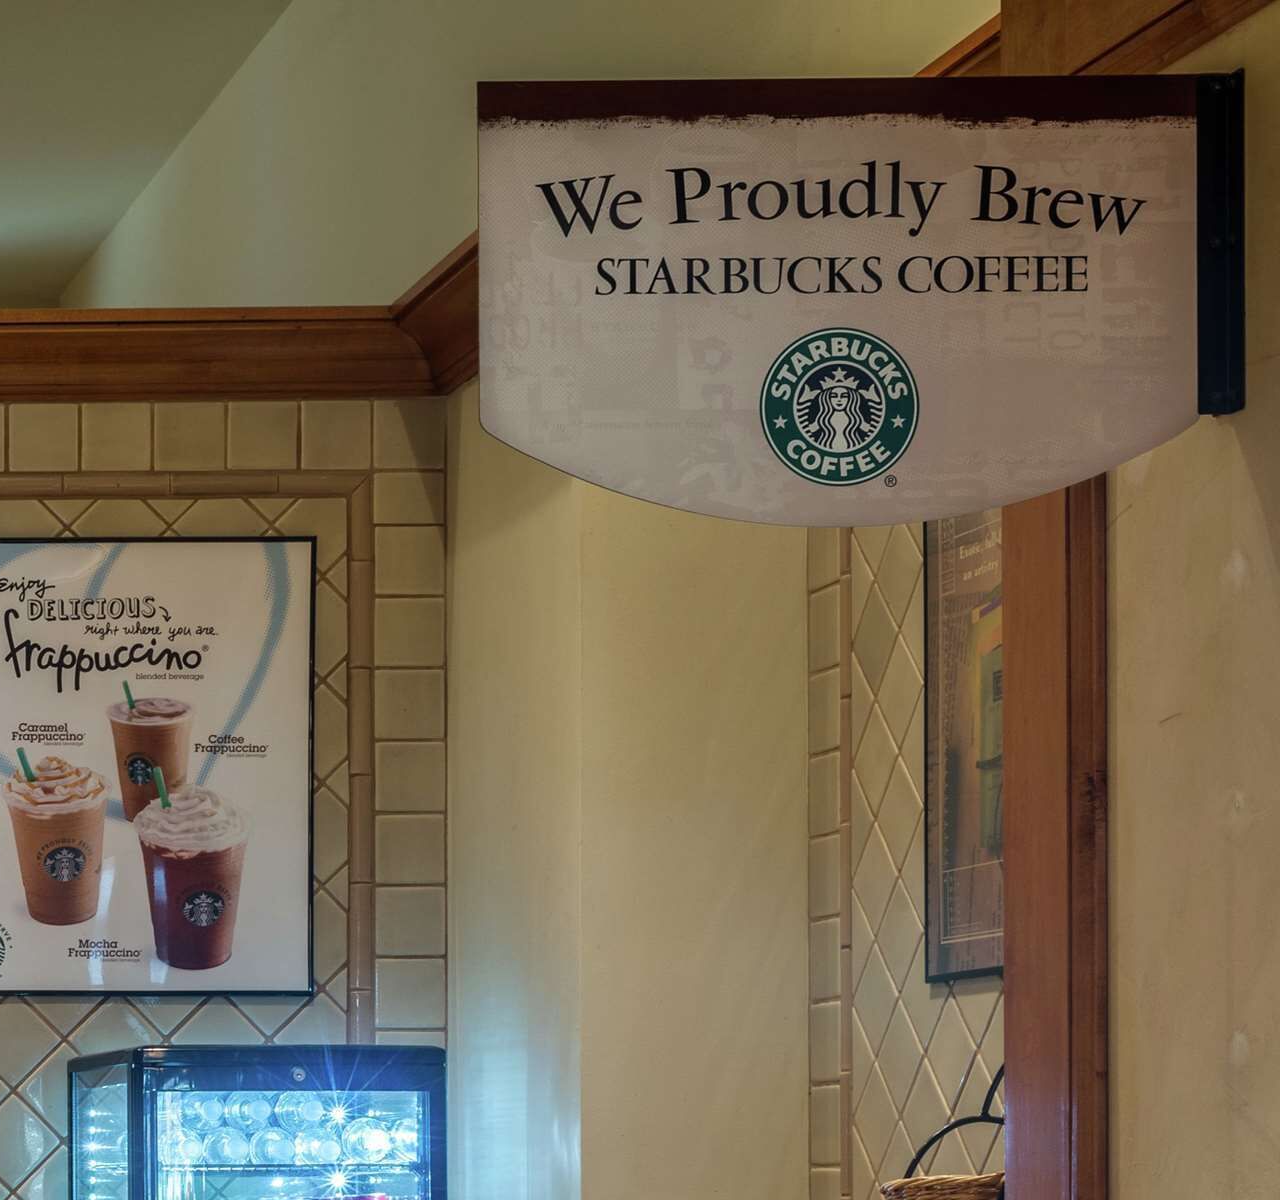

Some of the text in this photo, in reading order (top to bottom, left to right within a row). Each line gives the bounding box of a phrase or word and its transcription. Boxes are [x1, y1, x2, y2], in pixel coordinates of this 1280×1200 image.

[535, 159, 1148, 238] We Proudly Brew
[595, 255, 1089, 296] STARBUCKS COFFEE
[771, 337, 908, 400] STARBUCKS
[786, 439, 892, 477] COFFEE
[26, 596, 156, 621] DELICIOUS
[83, 622, 120, 637] right
[122, 622, 162, 636] where
[168, 627, 192, 641] you
[135, 672, 205, 682] blended beverage
[17, 723, 69, 734] Caramel
[11, 732, 84, 743] Frappuccino
[207, 734, 245, 745] Coffee
[194, 743, 269, 755] Frappuccino
[78, 939, 119, 949] Mocha
[67, 948, 142, 960] Frappuccino
